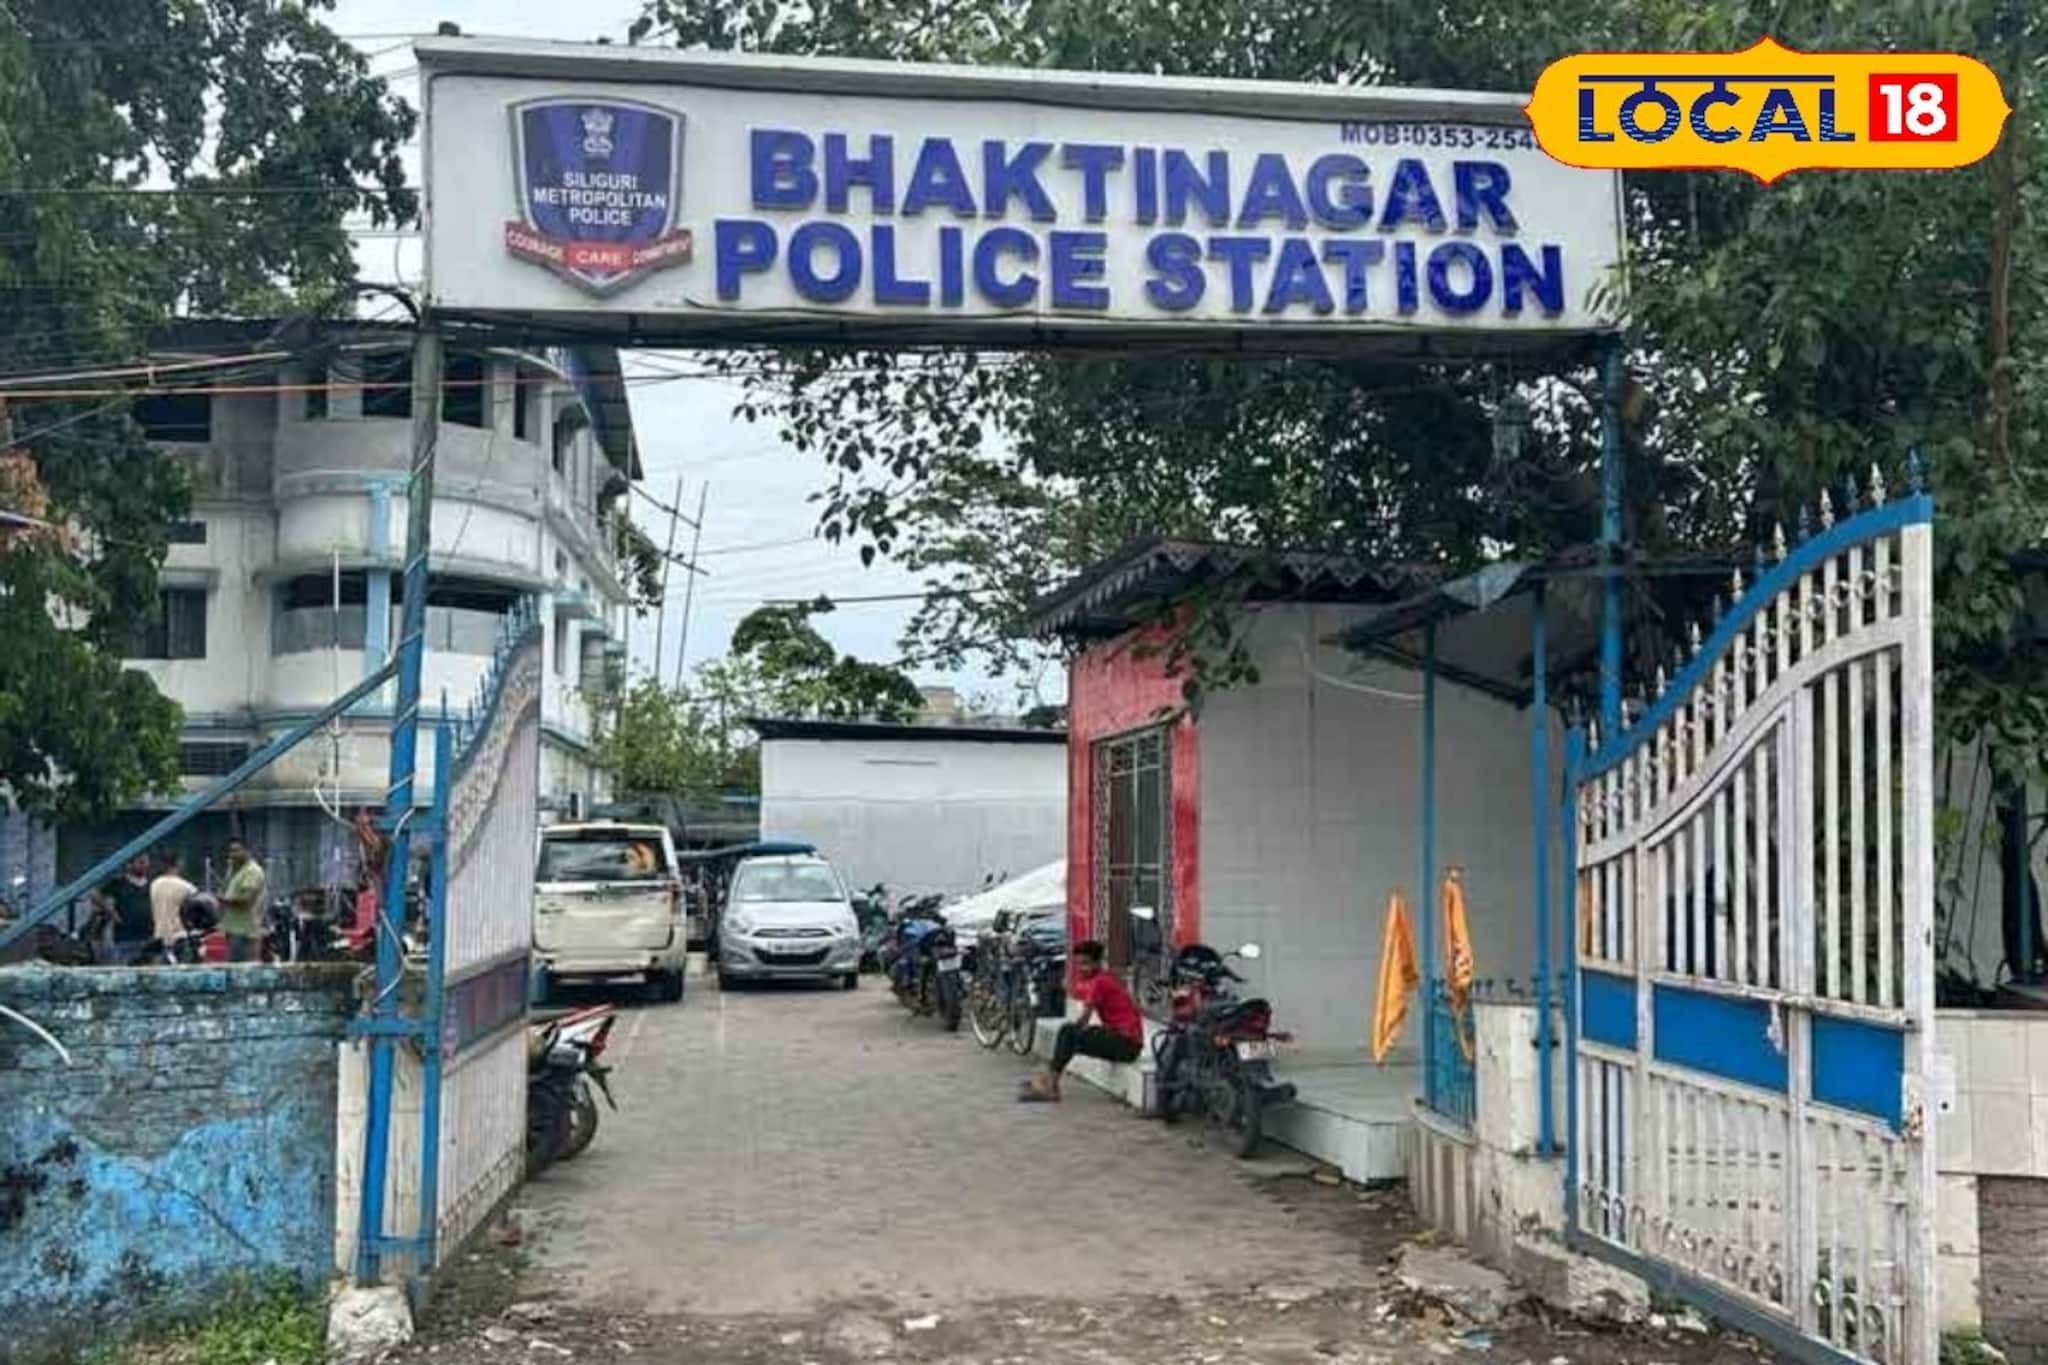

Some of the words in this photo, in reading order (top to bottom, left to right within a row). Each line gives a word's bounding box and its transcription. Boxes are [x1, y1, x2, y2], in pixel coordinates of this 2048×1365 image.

[1340, 121, 1541, 151] MOB:0353-254
[562, 171, 638, 190] SILIGURI
[749, 128, 1519, 237] BHAKTINAGAR
[533, 187, 667, 209] METROPOLITAN
[568, 207, 632, 226] POLICE
[575, 249, 625, 266] CARE
[713, 218, 1112, 311] POLICE
[1145, 232, 1566, 319] STATION
